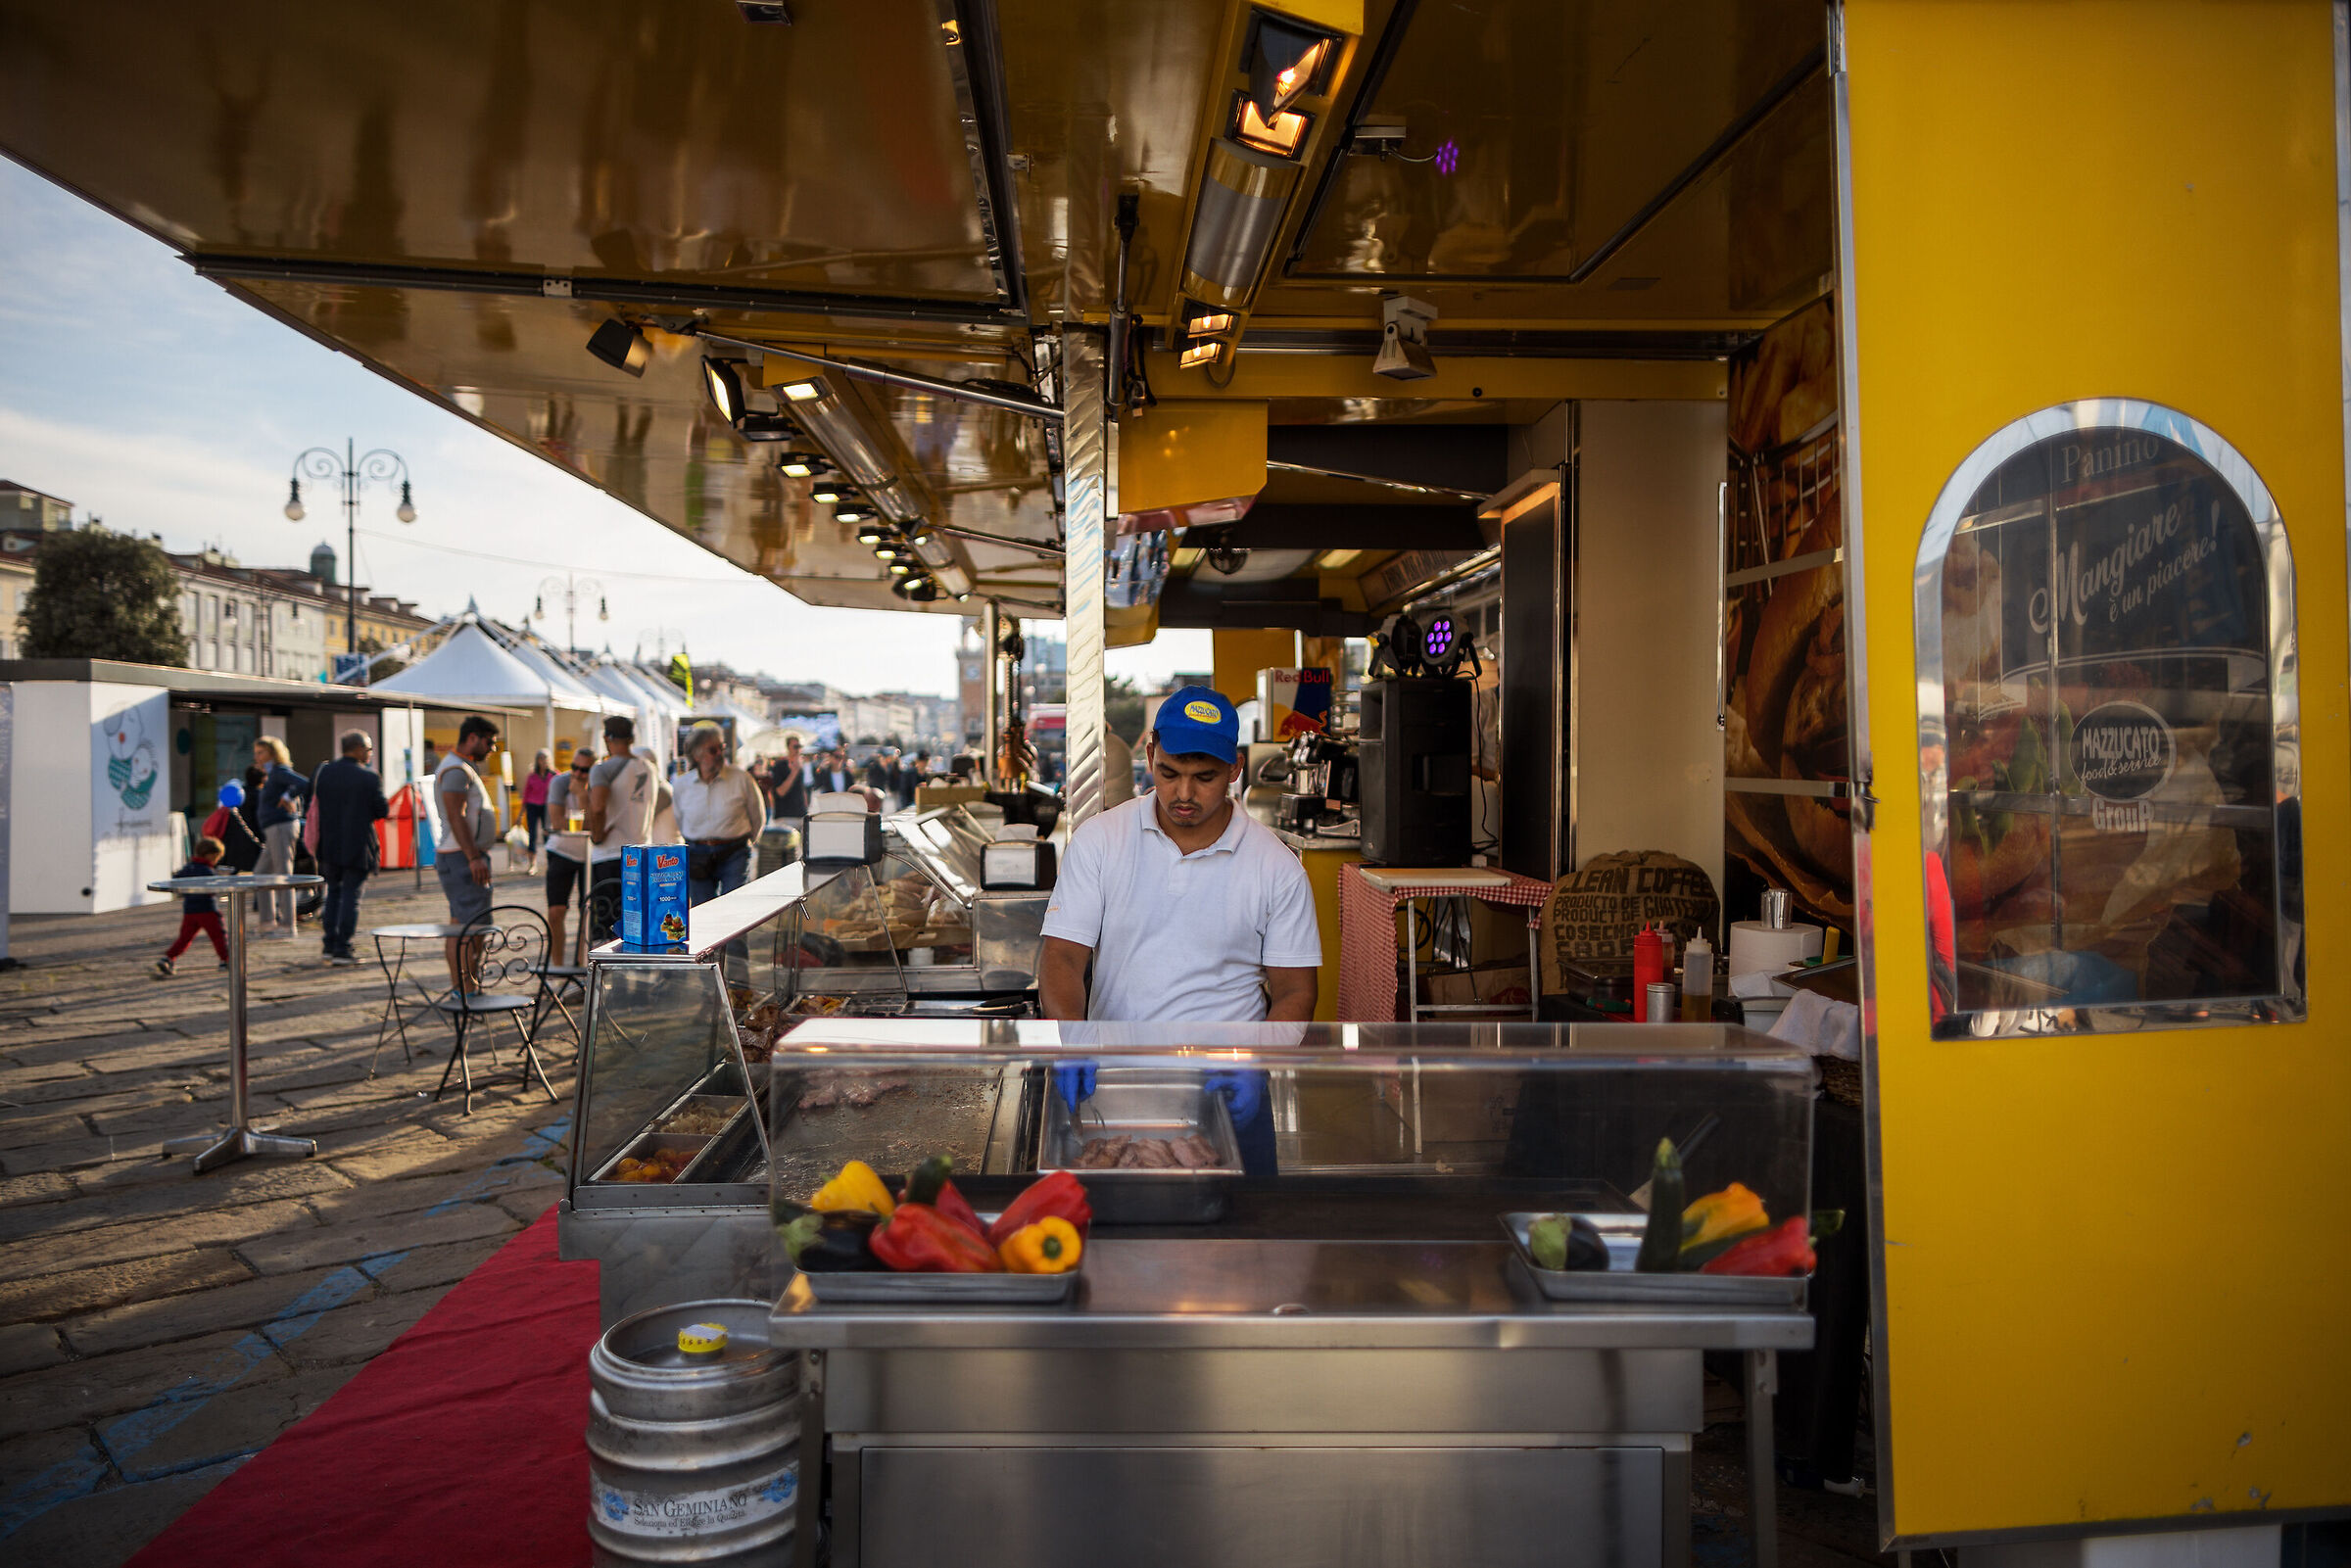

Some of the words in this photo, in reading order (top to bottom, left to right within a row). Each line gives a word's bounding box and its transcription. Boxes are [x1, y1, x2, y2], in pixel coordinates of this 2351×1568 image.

[2060, 433, 2160, 484] Panino
[2029, 503, 2182, 635] Mangiare
[2122, 585, 2144, 614] un
[2146, 499, 2221, 606] piacere!
[1274, 669, 1302, 683] Red
[1303, 669, 1330, 684] Bull
[2082, 726, 2160, 760] MAZZUCATO
[656, 854, 679, 870] Vanto
[1636, 867, 1713, 898] COFFEE
[1553, 908, 1617, 923] PRODUCT
[1621, 909, 1641, 922] OF
[1554, 895, 1615, 909] PRODUCTO
[1621, 895, 1641, 910] DE
